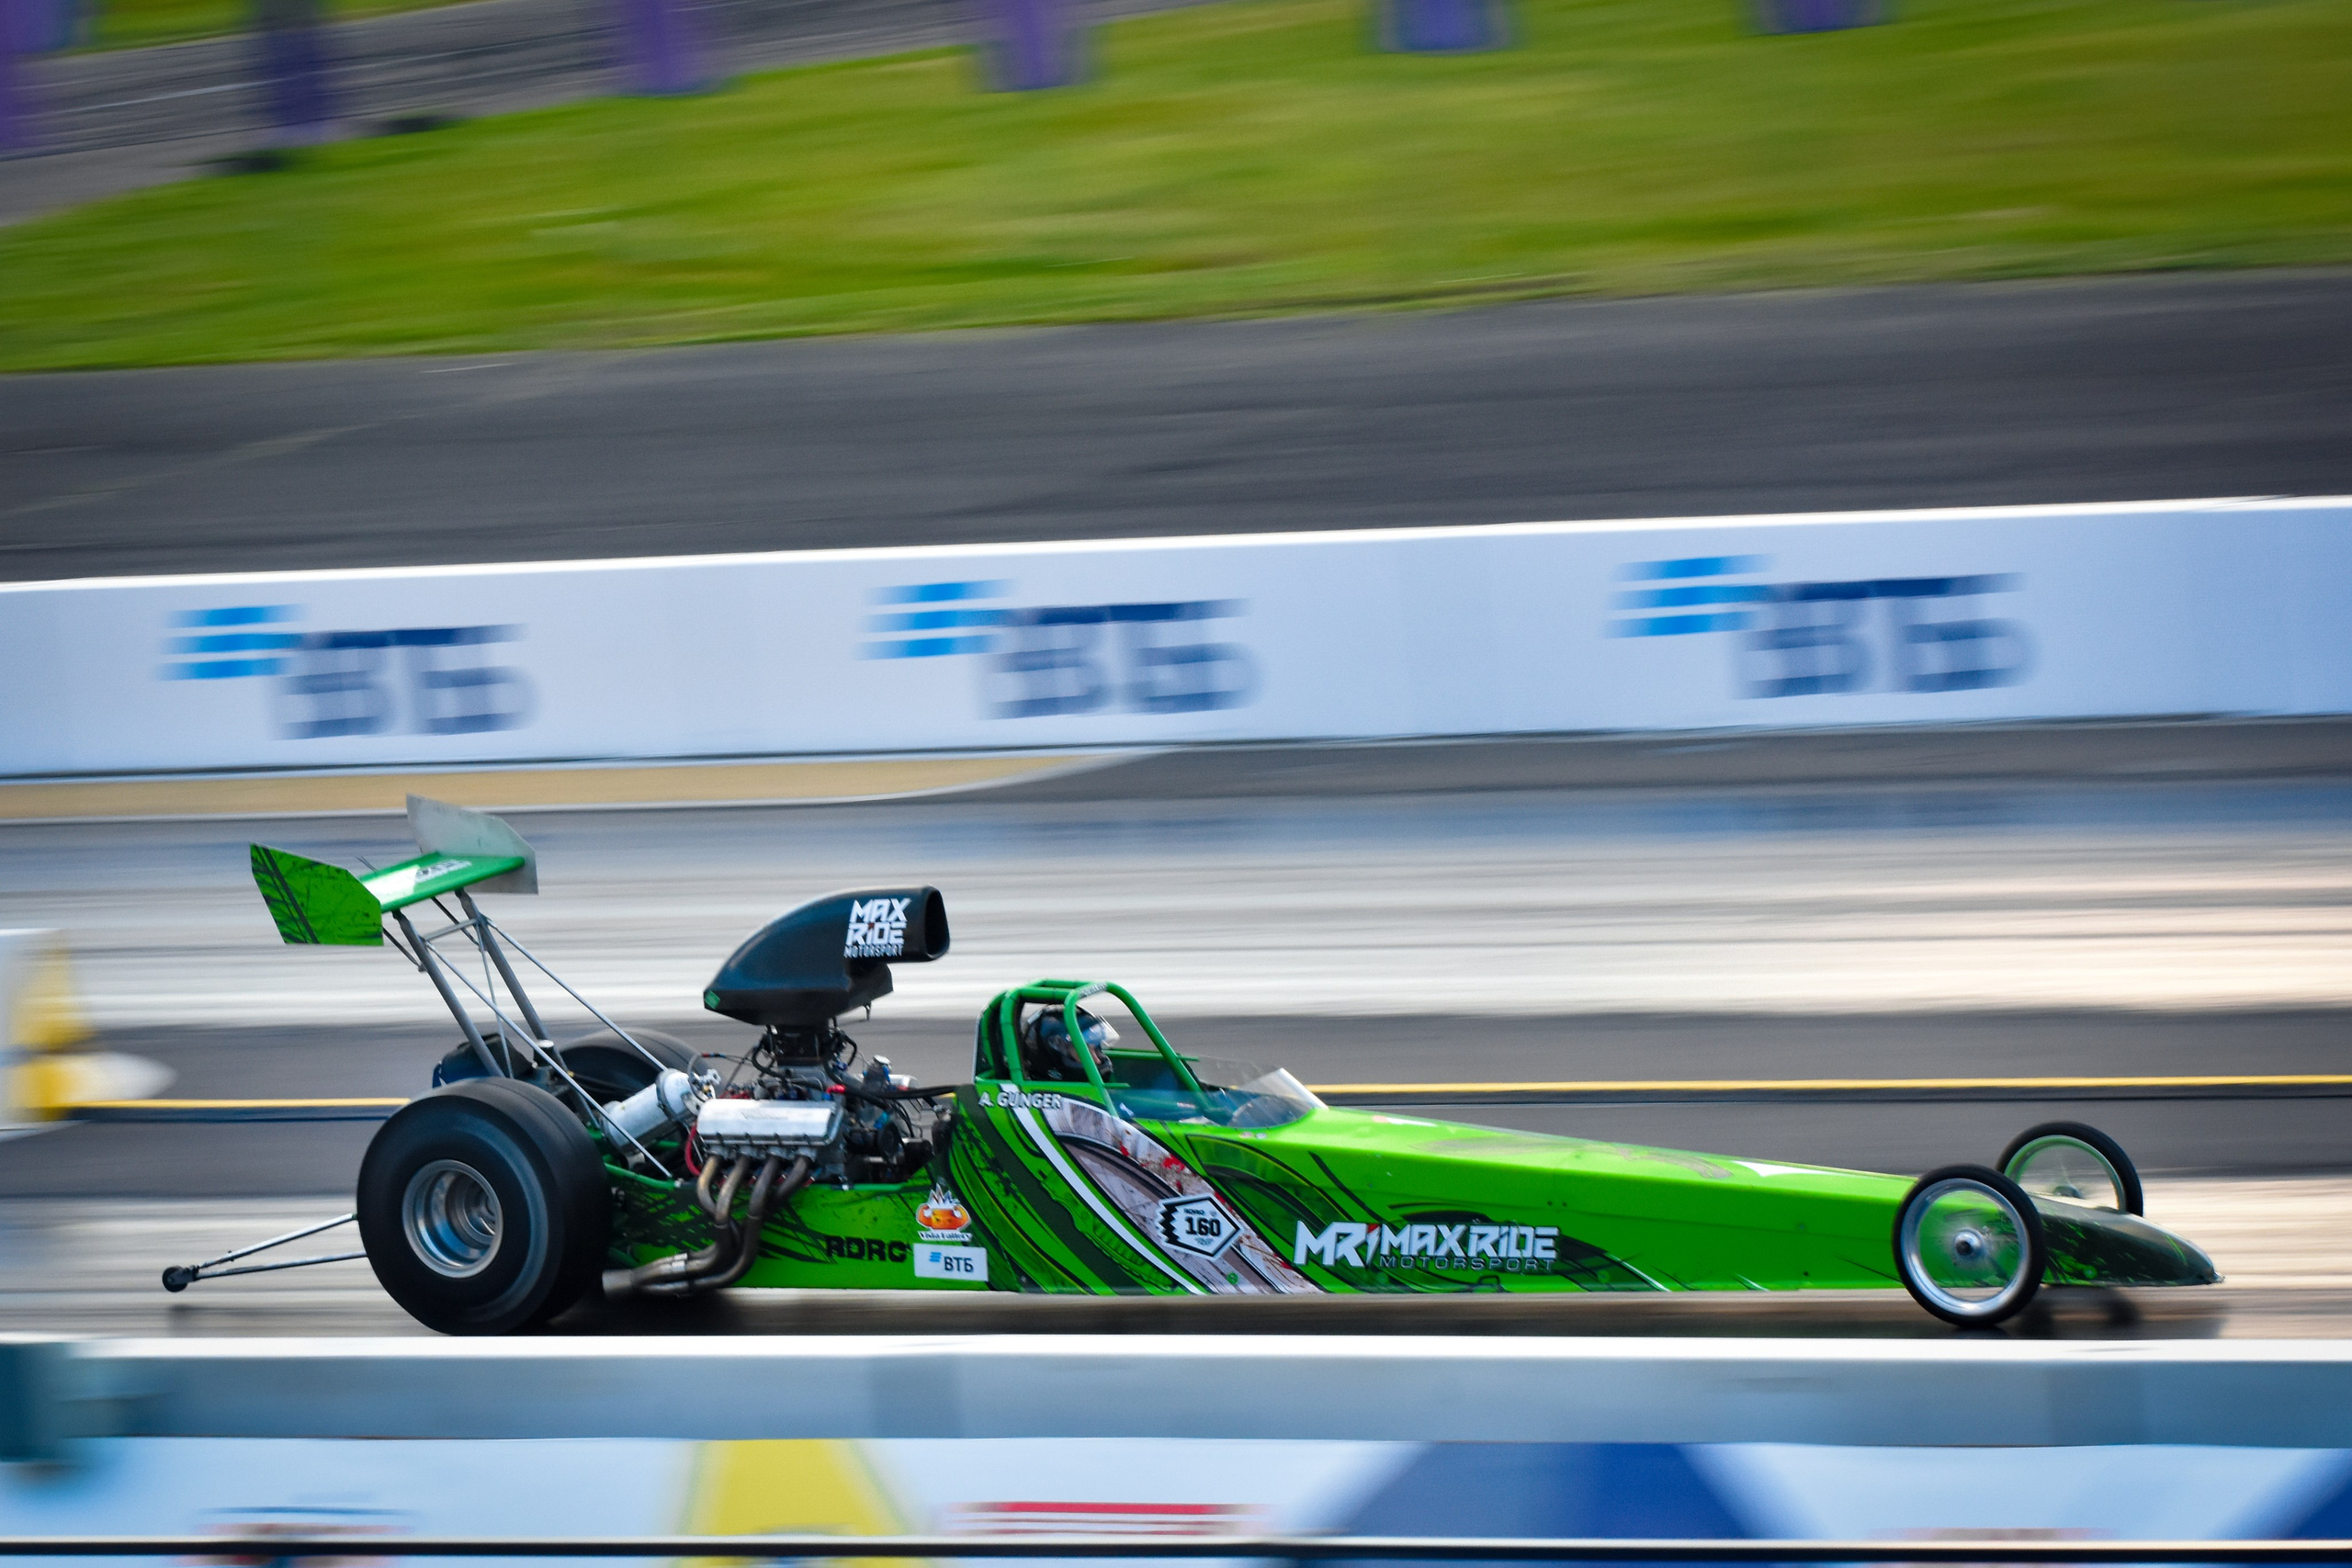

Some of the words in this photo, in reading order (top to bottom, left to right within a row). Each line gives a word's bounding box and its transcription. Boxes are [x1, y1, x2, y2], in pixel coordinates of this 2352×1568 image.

[849, 898, 910, 922] MAX
[843, 944, 904, 958] MOTORSPORT
[1185, 1216, 1221, 1236] 160
[826, 1235, 907, 1263] RDRC
[944, 1256, 974, 1273] ВТБ
[1380, 1256, 1555, 1270] MOTORSPORT
